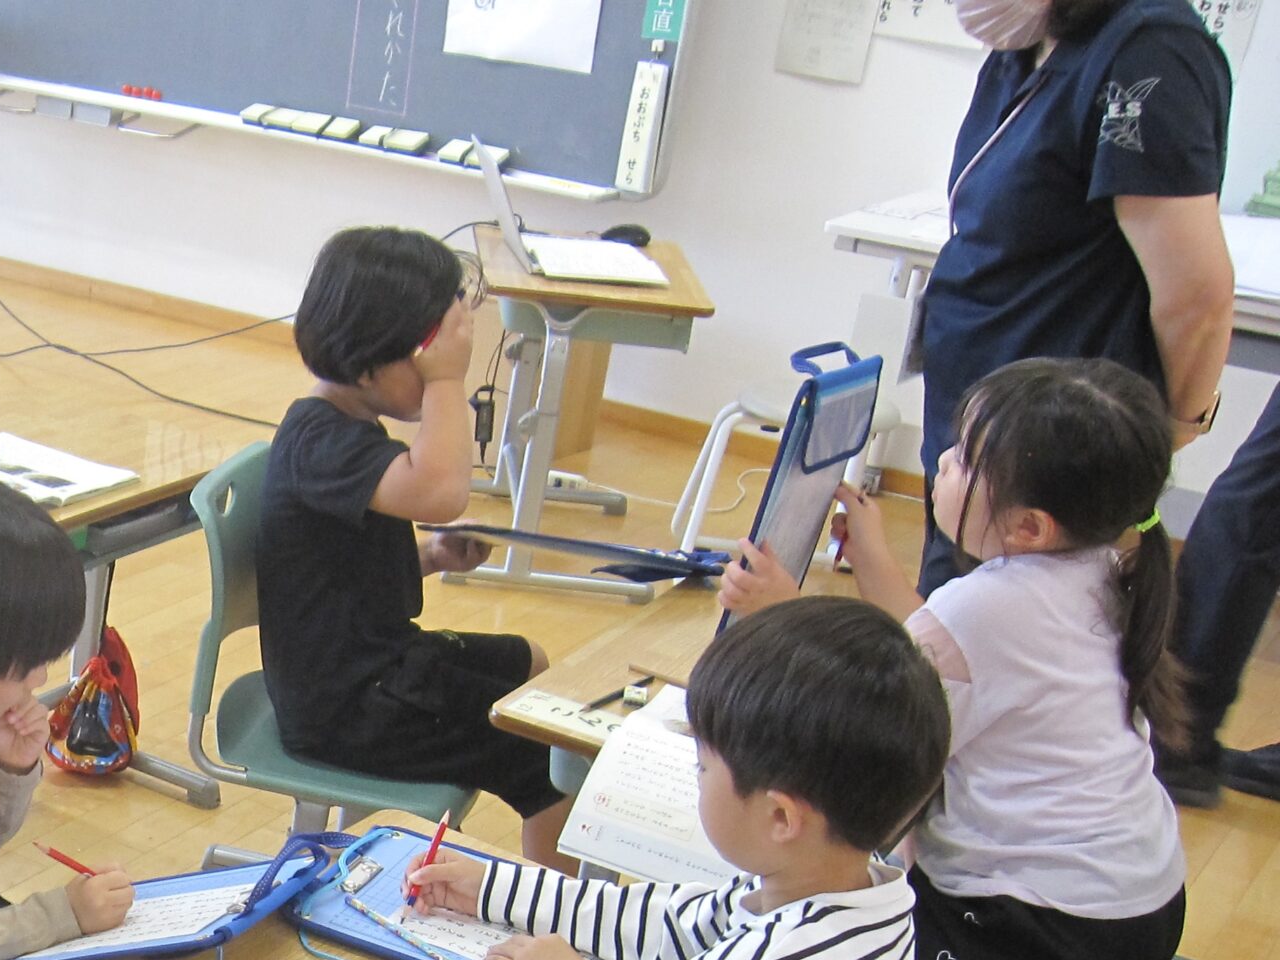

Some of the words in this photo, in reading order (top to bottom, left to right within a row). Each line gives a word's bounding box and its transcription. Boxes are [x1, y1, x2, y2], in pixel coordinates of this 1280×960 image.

[378, 0, 404, 106] れかた
[632, 87, 650, 142] おおぶち
[625, 158, 636, 185] せら
